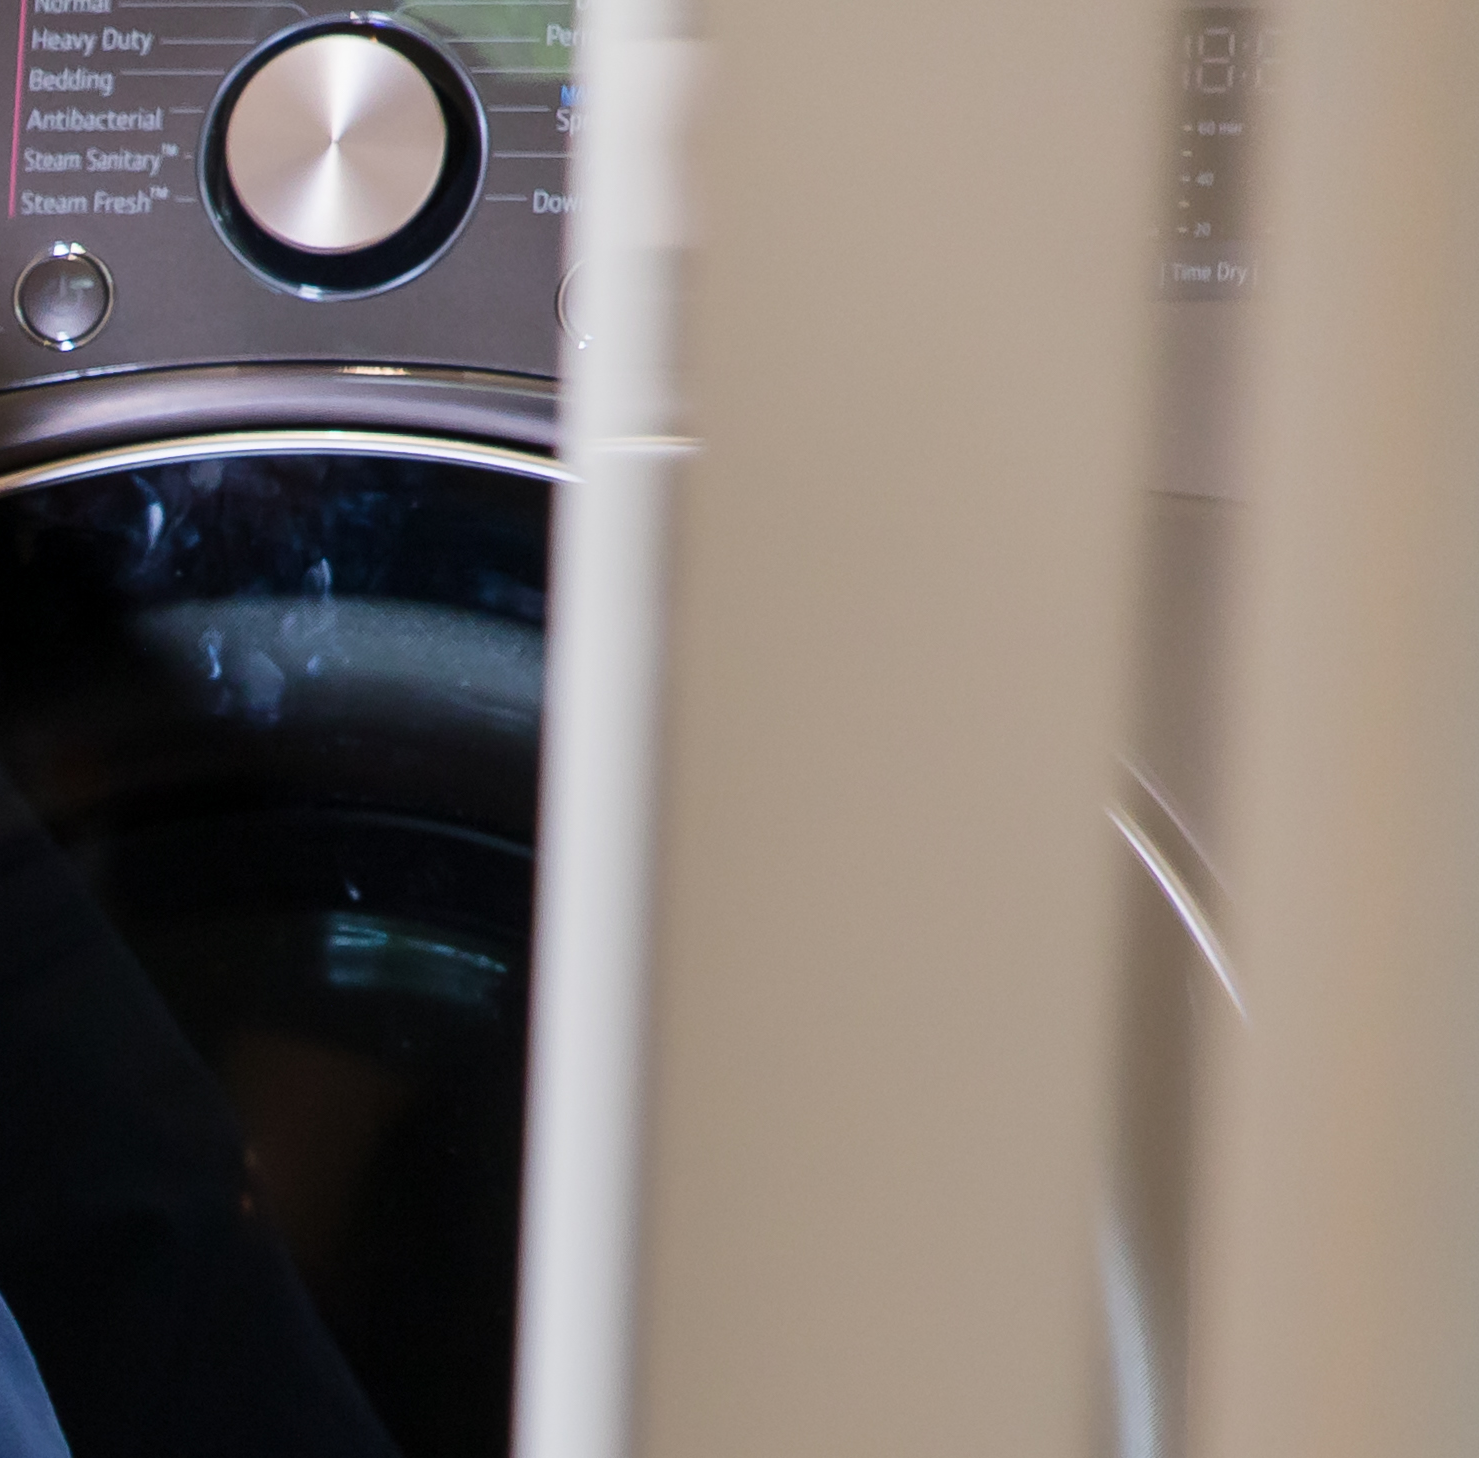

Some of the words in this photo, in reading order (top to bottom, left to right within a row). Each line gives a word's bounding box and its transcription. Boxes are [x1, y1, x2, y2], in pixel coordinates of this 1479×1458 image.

[31, 27, 98, 57] Heavy
[102, 26, 155, 56] Duty
[29, 66, 114, 97] Bedding
[26, 106, 162, 132] Antibacterial
[24, 147, 82, 172] Steam
[21, 189, 88, 215] Steam
[1173, 262, 1212, 282] Time
[1217, 261, 1249, 286] Dry
